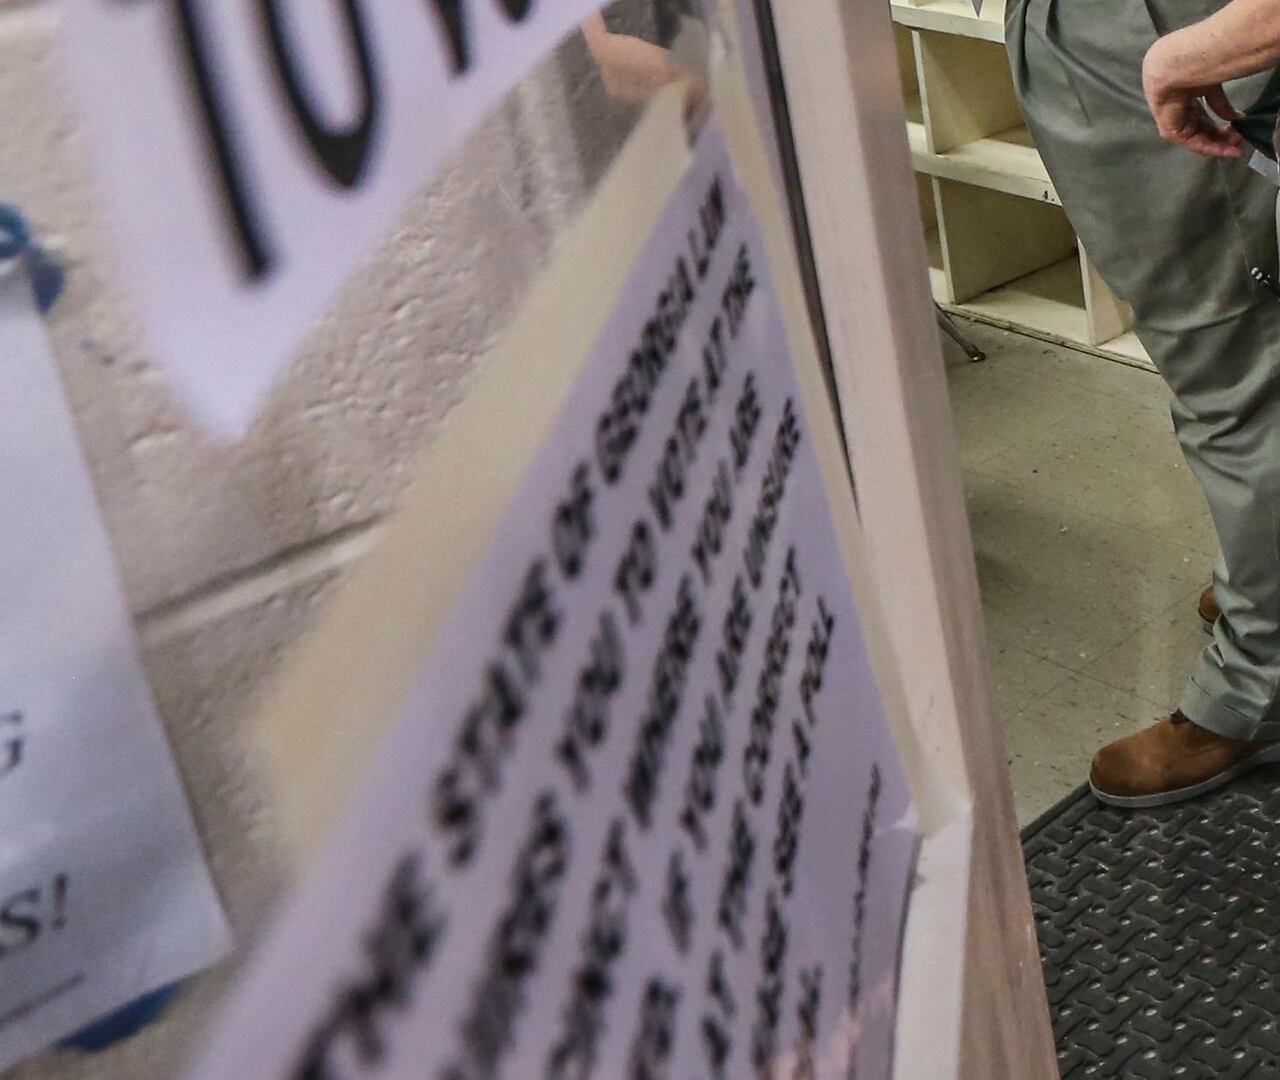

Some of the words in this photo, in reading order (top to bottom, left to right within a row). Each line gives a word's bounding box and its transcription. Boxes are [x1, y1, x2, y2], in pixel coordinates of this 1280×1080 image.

[434, 556, 560, 866] STATE
[553, 462, 597, 578] OF
[597, 256, 694, 486] GEORGIA
[554, 612, 626, 794] YOU
[614, 520, 656, 626] TO
[648, 377, 707, 532] VOTE
[624, 572, 699, 830] WHERE
[691, 459, 731, 588] YOU
